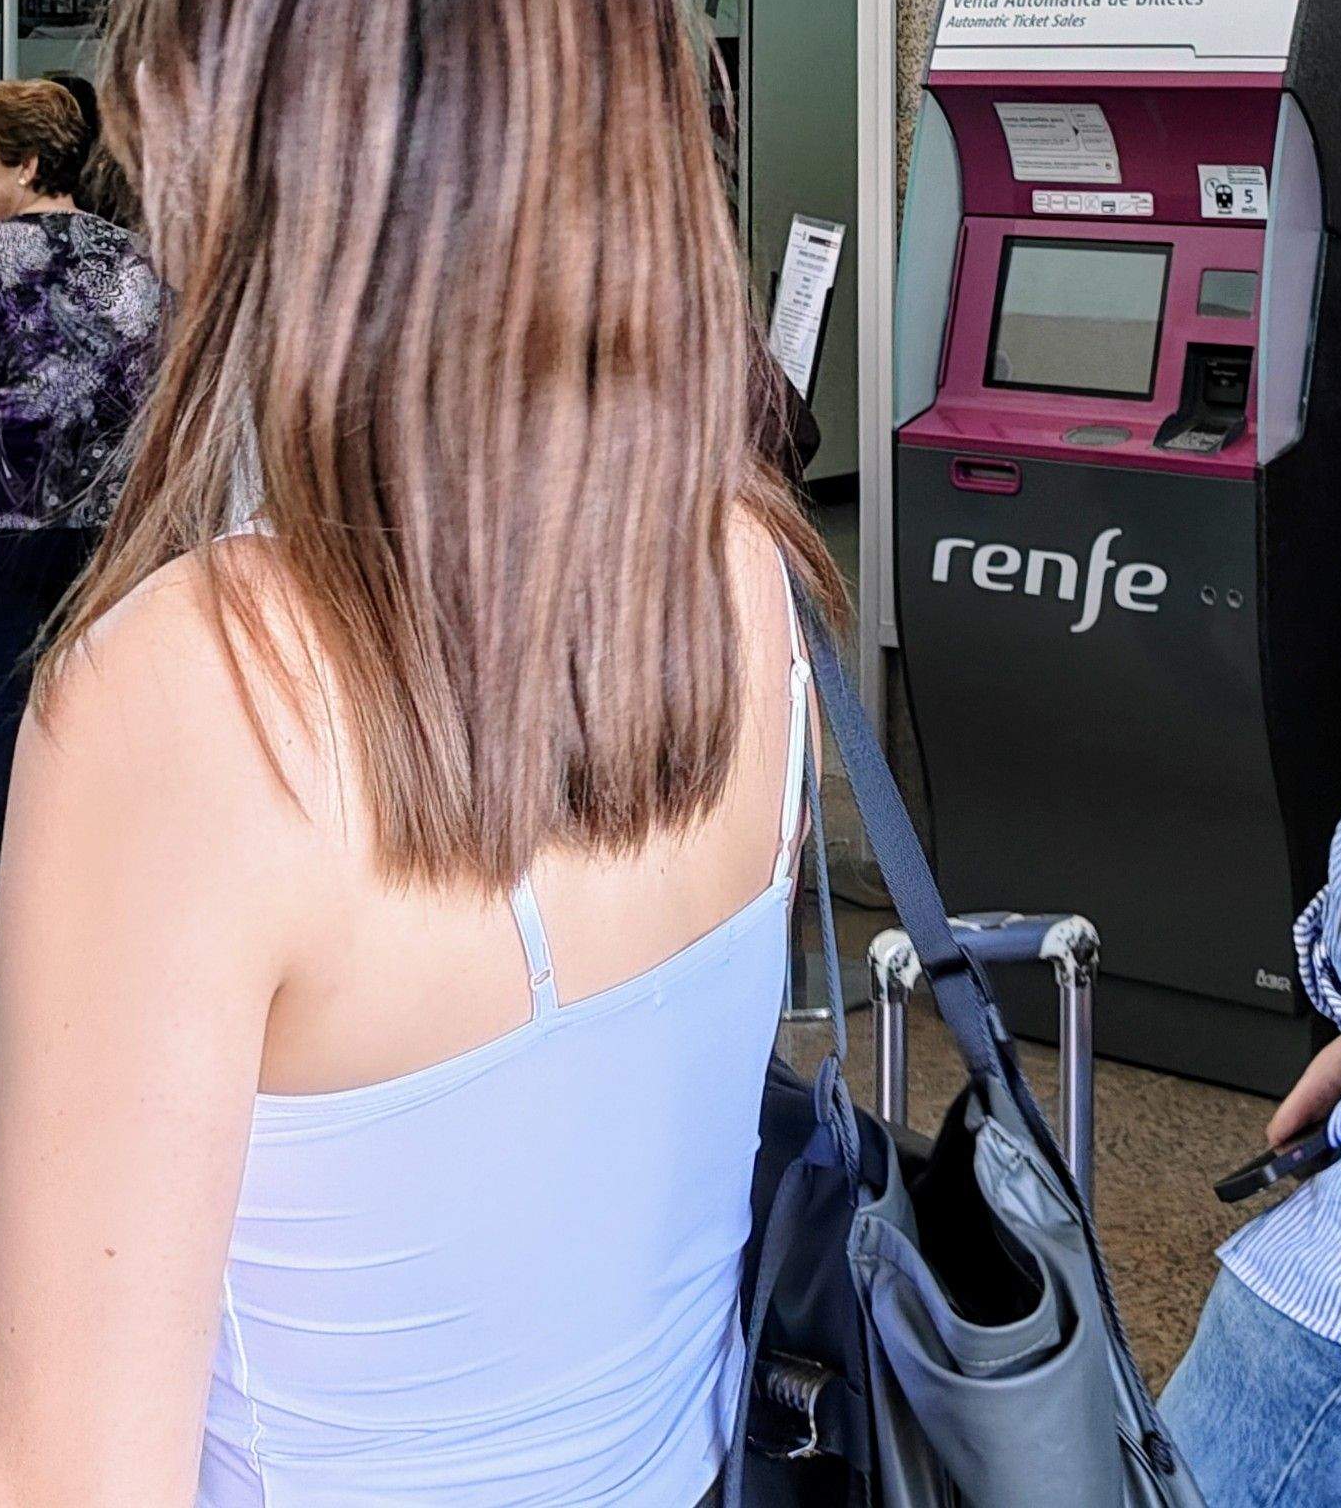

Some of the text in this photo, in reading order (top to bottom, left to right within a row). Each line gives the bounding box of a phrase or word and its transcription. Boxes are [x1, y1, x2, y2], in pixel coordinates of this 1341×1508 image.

[946, 14, 1087, 28] Automatic Ticket Sales
[1244, 189, 1253, 203] 5
[931, 527, 1168, 634] renfe
